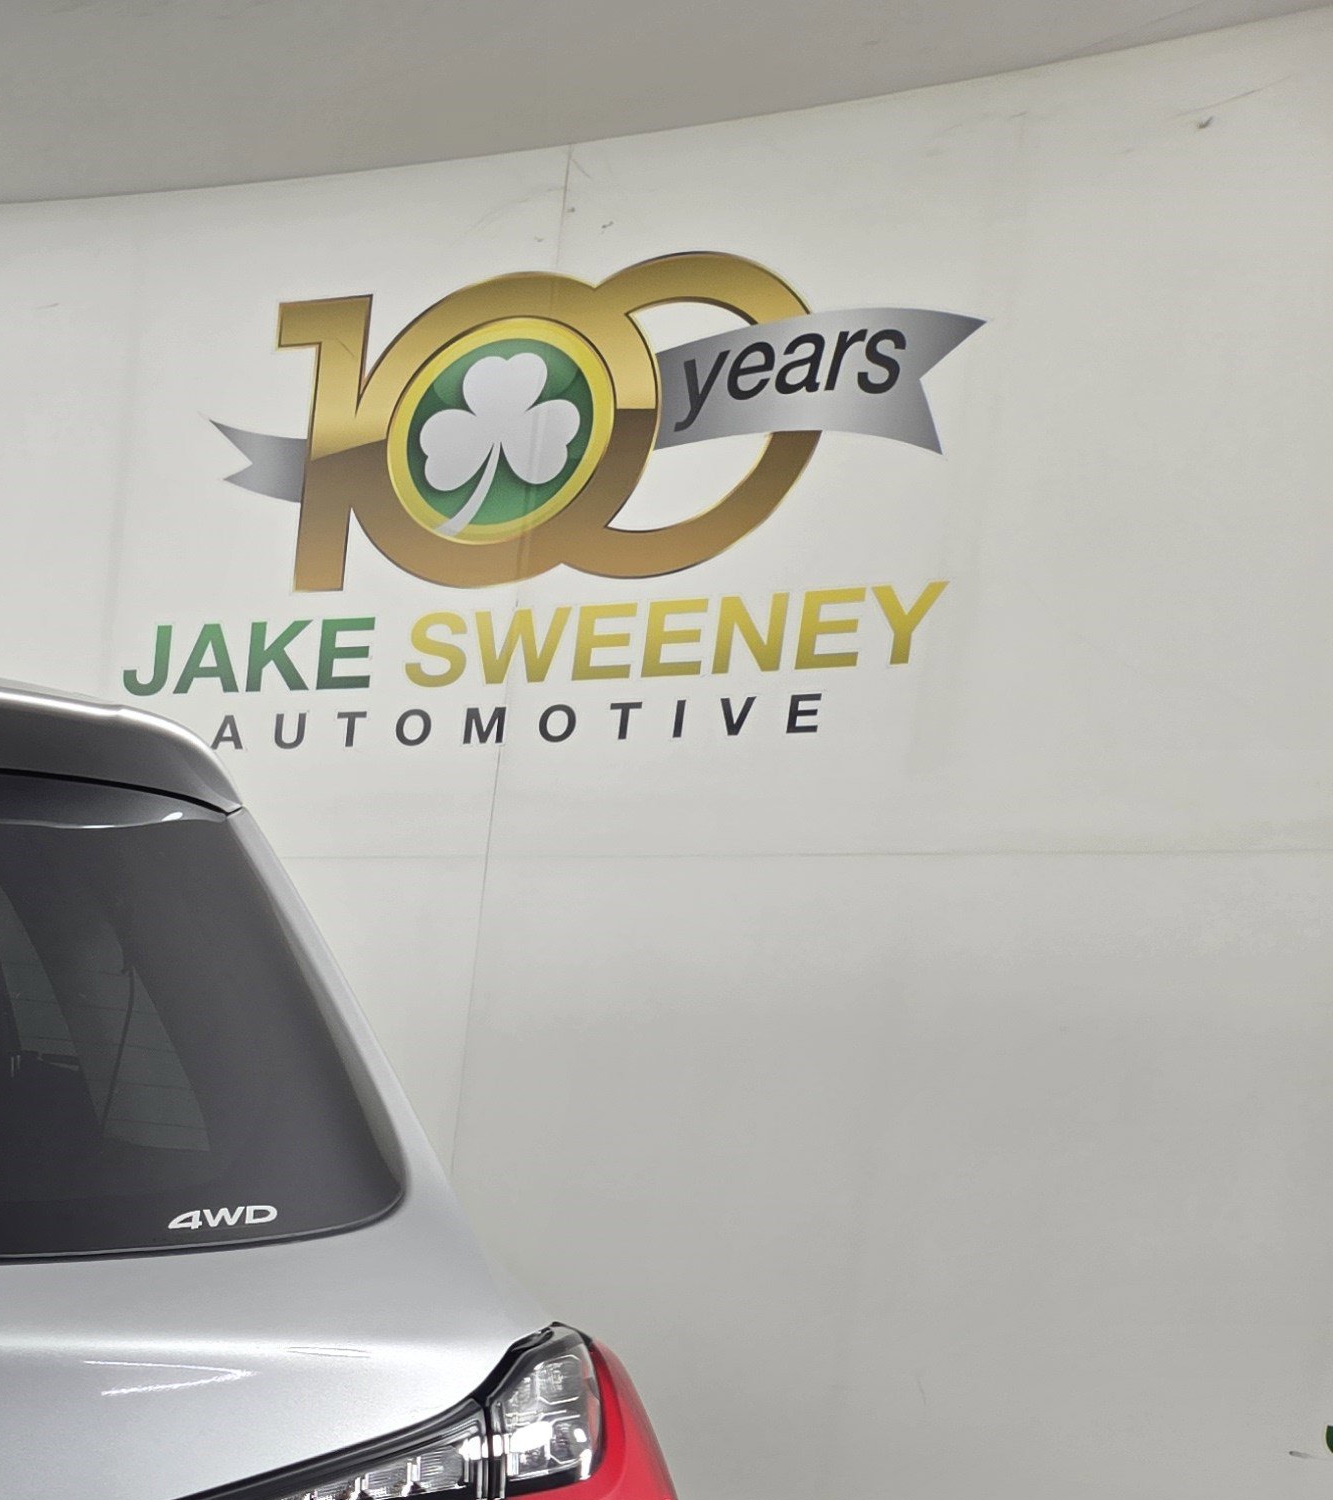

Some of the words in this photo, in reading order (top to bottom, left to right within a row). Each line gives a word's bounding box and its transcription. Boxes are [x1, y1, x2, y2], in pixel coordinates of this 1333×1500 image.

[277, 251, 823, 592] 100
[674, 326, 908, 432] years
[122, 616, 376, 697] JAKE
[404, 581, 949, 688] SWEENEY
[211, 694, 822, 752] AUTOMOTIVE
[168, 1205, 278, 1230] 4WD
